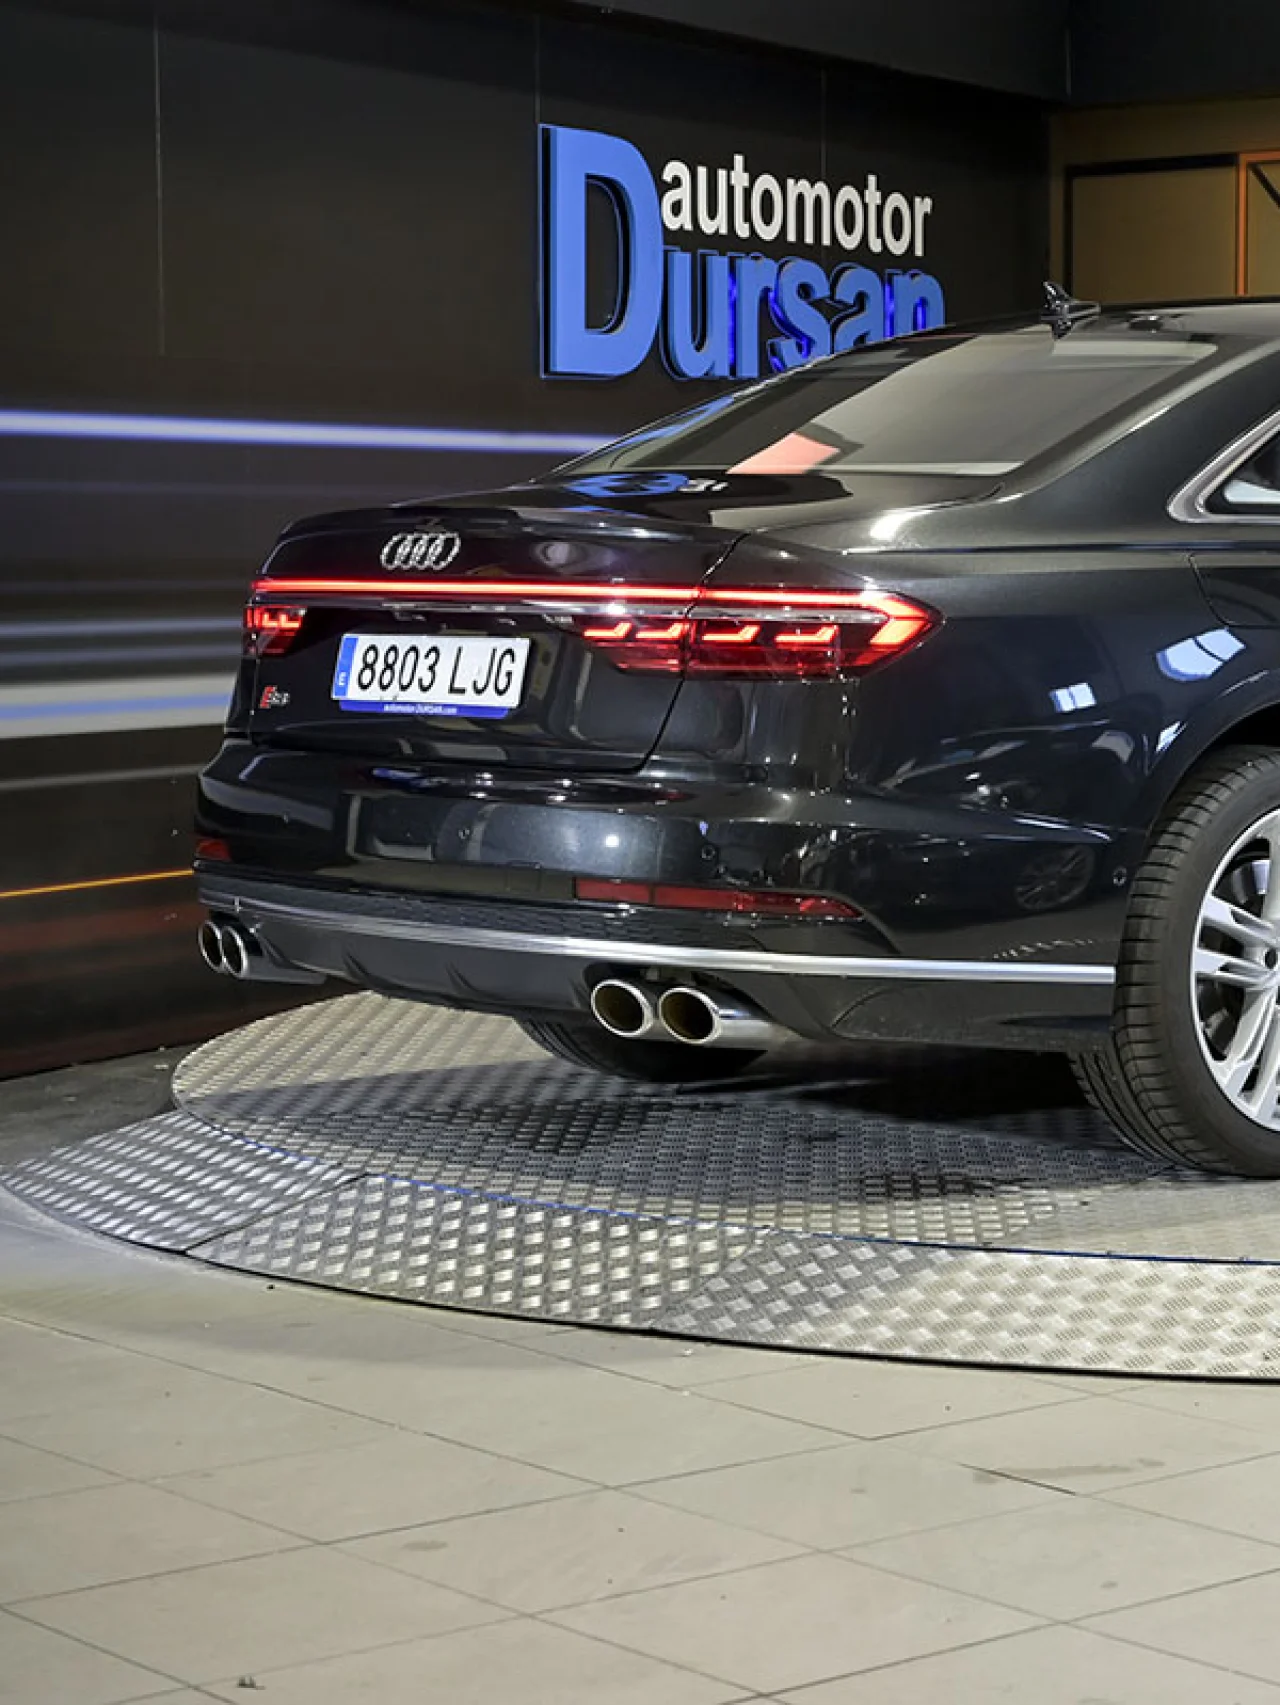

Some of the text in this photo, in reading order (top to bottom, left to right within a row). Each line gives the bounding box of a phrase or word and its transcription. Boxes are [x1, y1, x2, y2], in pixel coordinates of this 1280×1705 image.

[661, 153, 932, 257] automotor
[539, 124, 945, 379] Dursan
[338, 671, 347, 687] E
[357, 644, 516, 696] 8803 LJG
